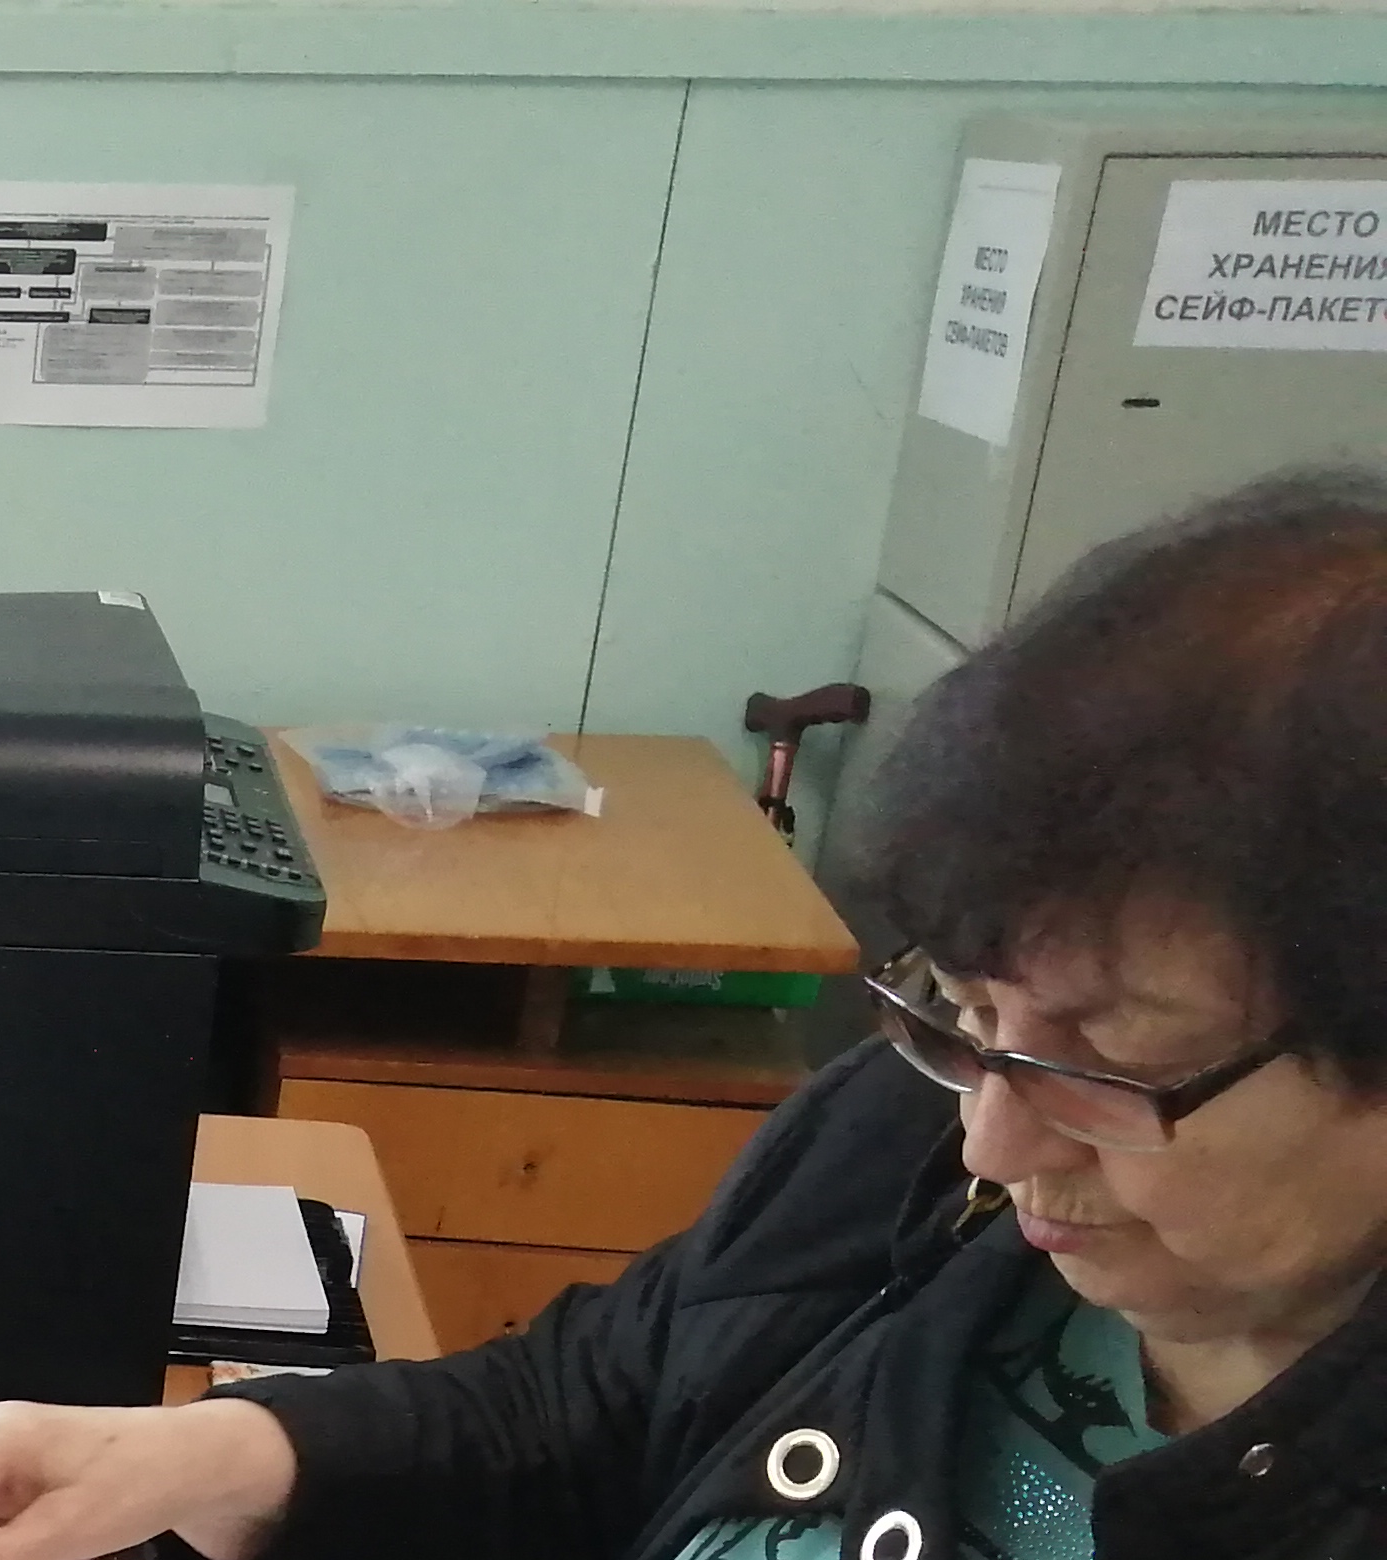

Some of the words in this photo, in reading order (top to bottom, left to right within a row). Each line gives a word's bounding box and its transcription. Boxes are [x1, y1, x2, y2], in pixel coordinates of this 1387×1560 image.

[1252, 210, 1381, 238] МЕСТО
[974, 246, 1009, 273] МЕСТО
[1154, 289, 1387, 323] СЕЙФ-ПАКЕТ
